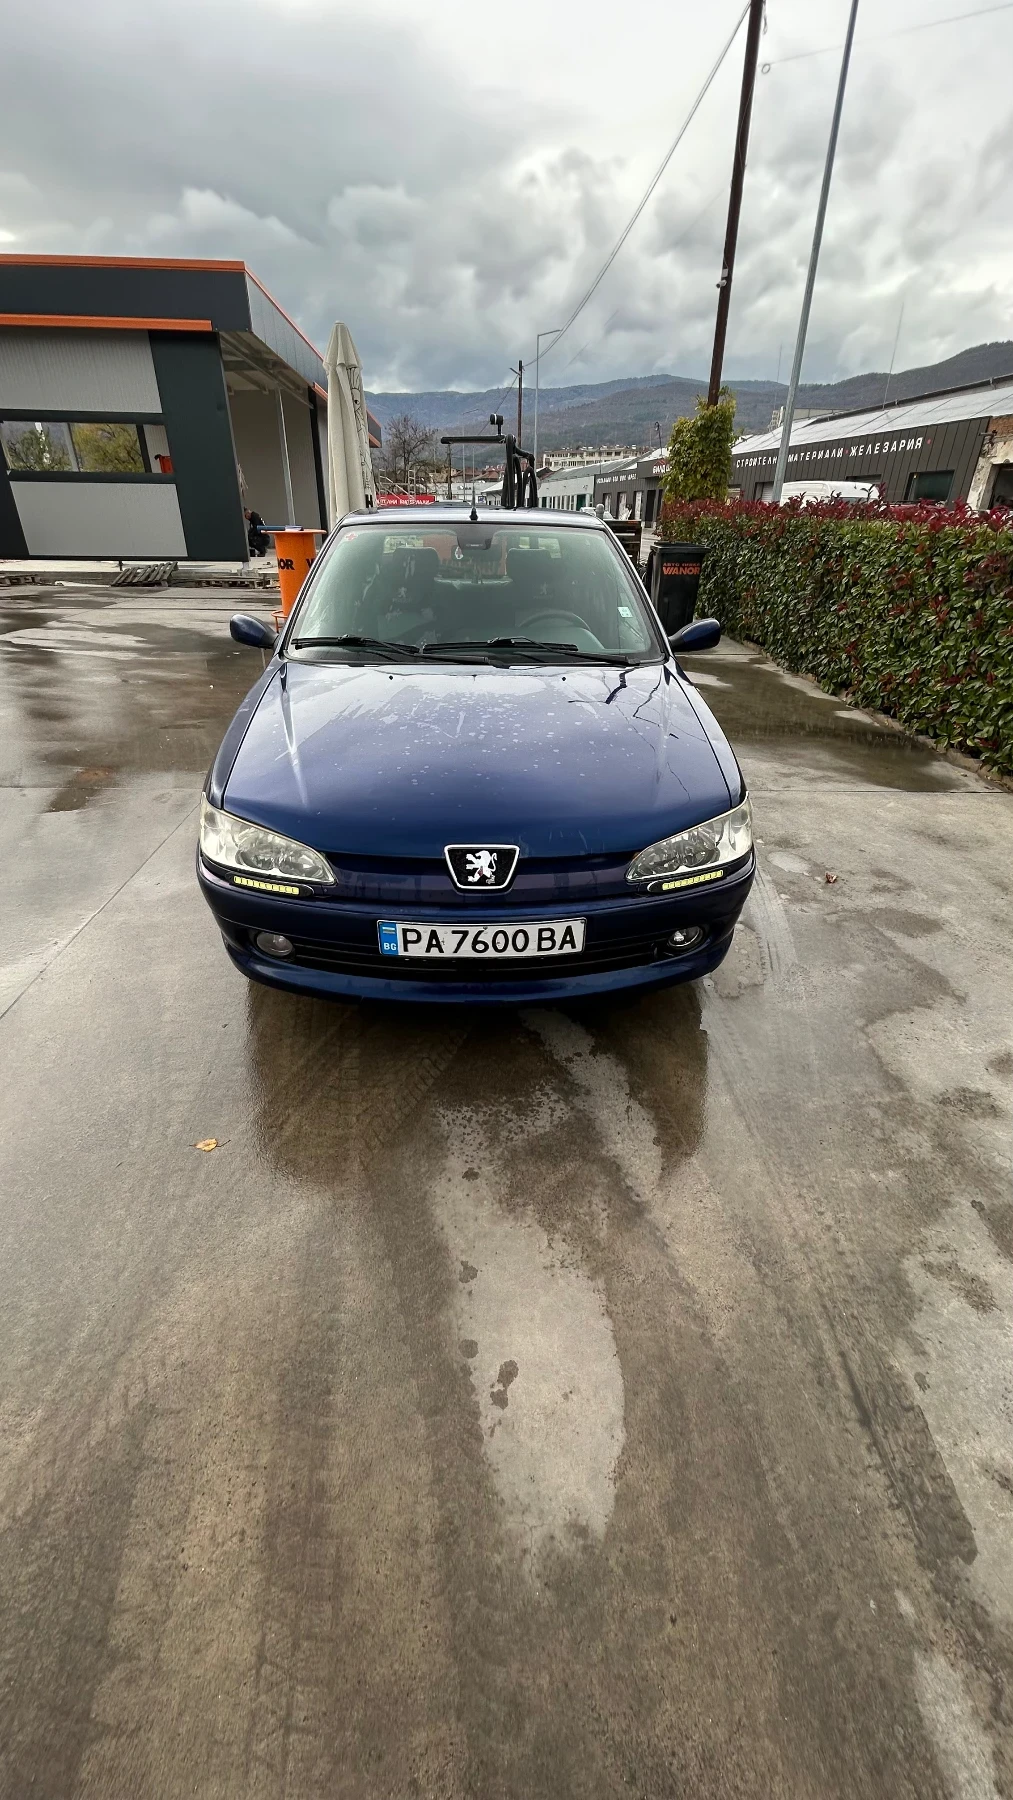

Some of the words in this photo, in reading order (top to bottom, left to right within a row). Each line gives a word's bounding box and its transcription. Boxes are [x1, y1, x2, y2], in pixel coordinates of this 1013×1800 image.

[736, 455, 778, 468] СТРОИТЕЛН
[787, 447, 843, 463] МАТЕРИАЛИ
[849, 436, 924, 457] ЖЕЛЕЗАРИЯ
[383, 942, 397, 951] BG
[401, 927, 444, 954] PA
[451, 928, 530, 954] 7600
[536, 925, 577, 952] BA
